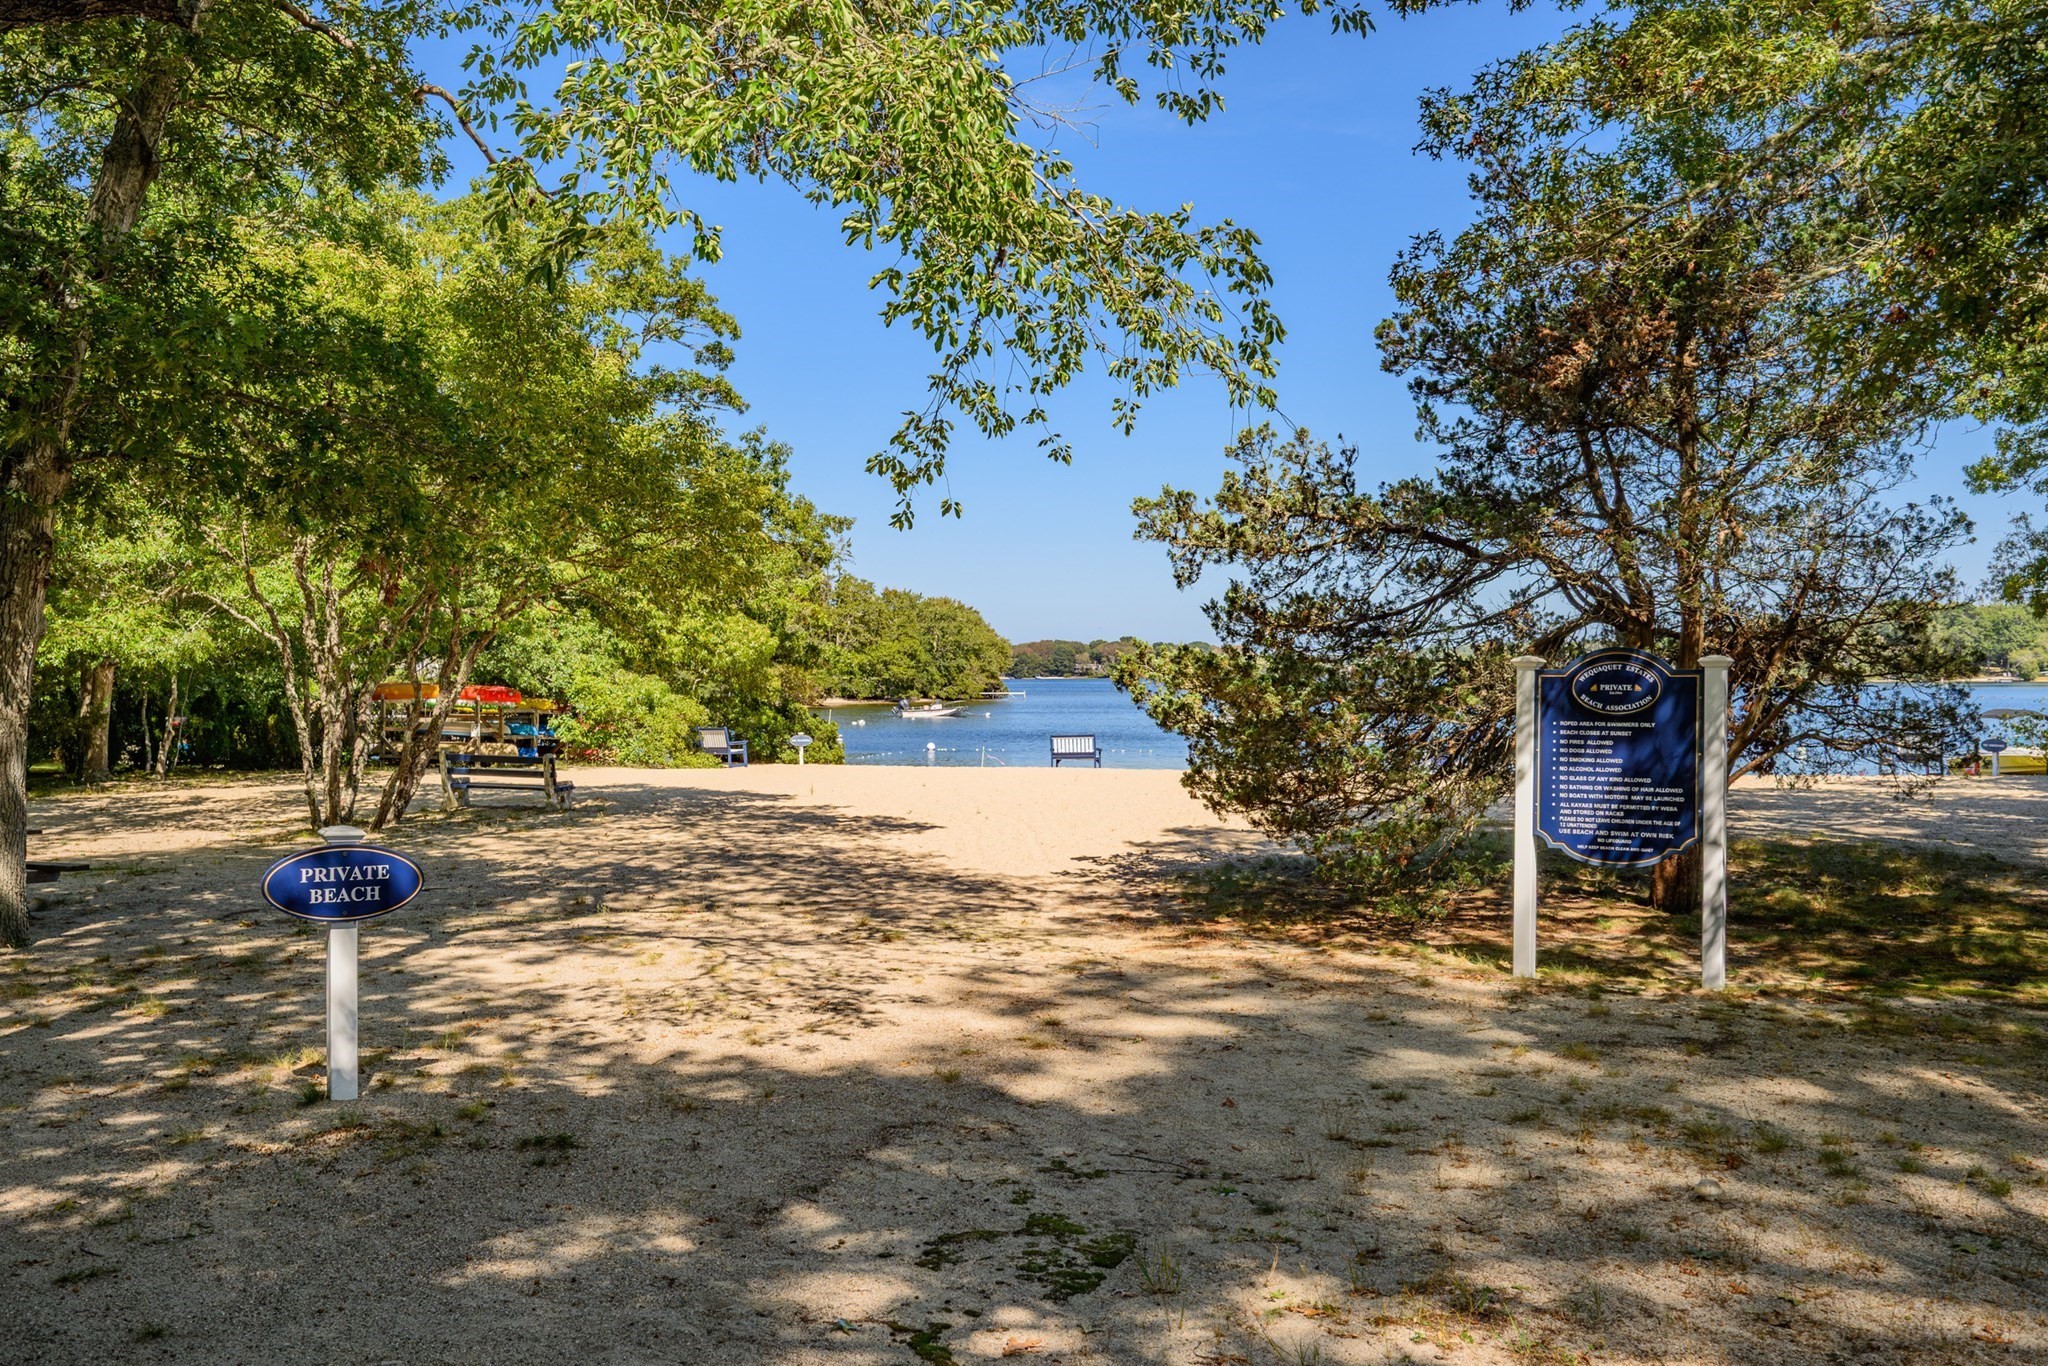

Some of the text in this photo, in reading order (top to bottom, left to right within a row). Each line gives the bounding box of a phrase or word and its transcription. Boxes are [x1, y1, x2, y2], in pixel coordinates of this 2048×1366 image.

[1579, 664, 1655, 683] WEQUAQUET ESTATES
[1580, 694, 1653, 711] BEACH ASSOCIATION
[300, 864, 390, 884] PRIVATE
[308, 886, 382, 904] BEACH
